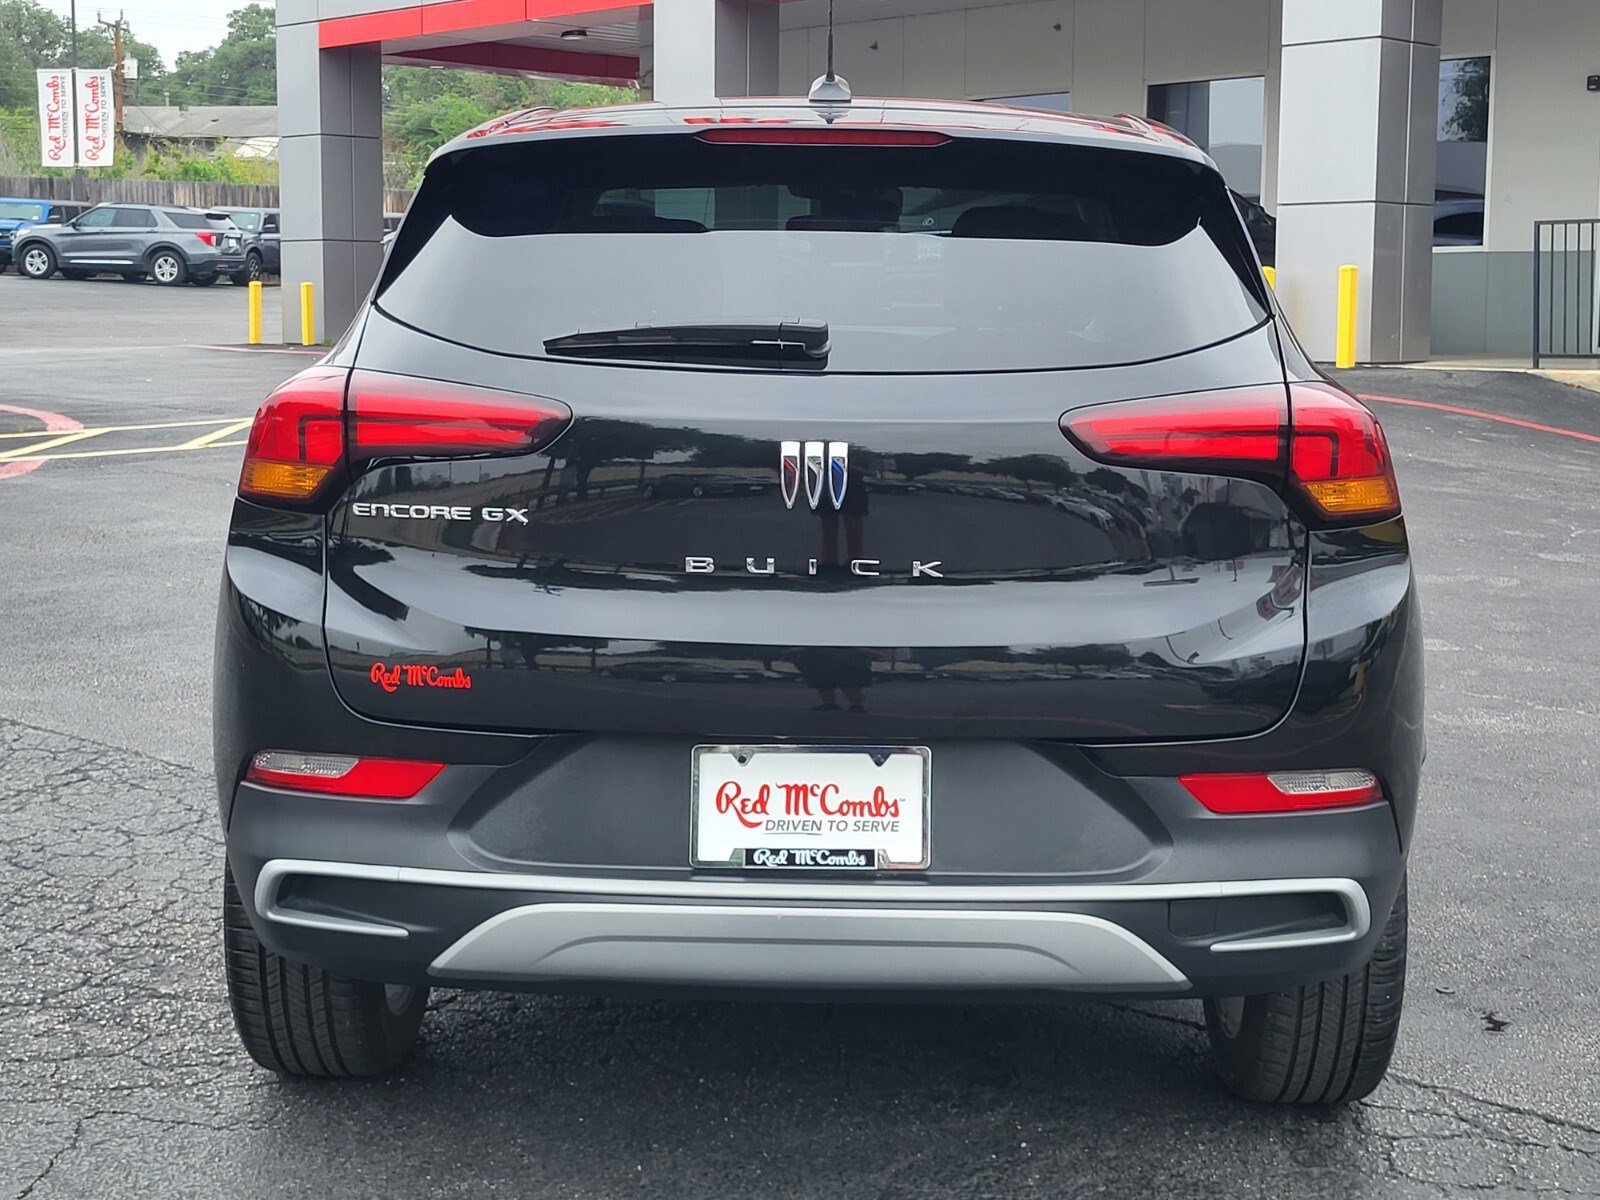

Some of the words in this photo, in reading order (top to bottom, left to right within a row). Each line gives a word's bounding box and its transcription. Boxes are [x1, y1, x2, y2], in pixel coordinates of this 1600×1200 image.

[46, 75, 61, 133] McCombs
[61, 99, 67, 108] TO
[84, 75, 100, 133] McCombs
[101, 99, 107, 109] TO
[101, 112, 109, 138] DRIVEN
[48, 136, 66, 160] Red
[85, 136, 105, 160] Red
[352, 502, 472, 520] ENCORE
[481, 507, 529, 525] GX
[685, 556, 944, 578] BUICK
[370, 662, 400, 693] Red
[402, 664, 472, 689] McCombs
[715, 781, 770, 829] Red
[775, 783, 900, 818] McCombs
[764, 819, 822, 832] DRIVEN
[827, 820, 848, 832] TO
[852, 820, 900, 832] SERVE
[752, 848, 788, 867] Red
[789, 849, 866, 866] McCombs
